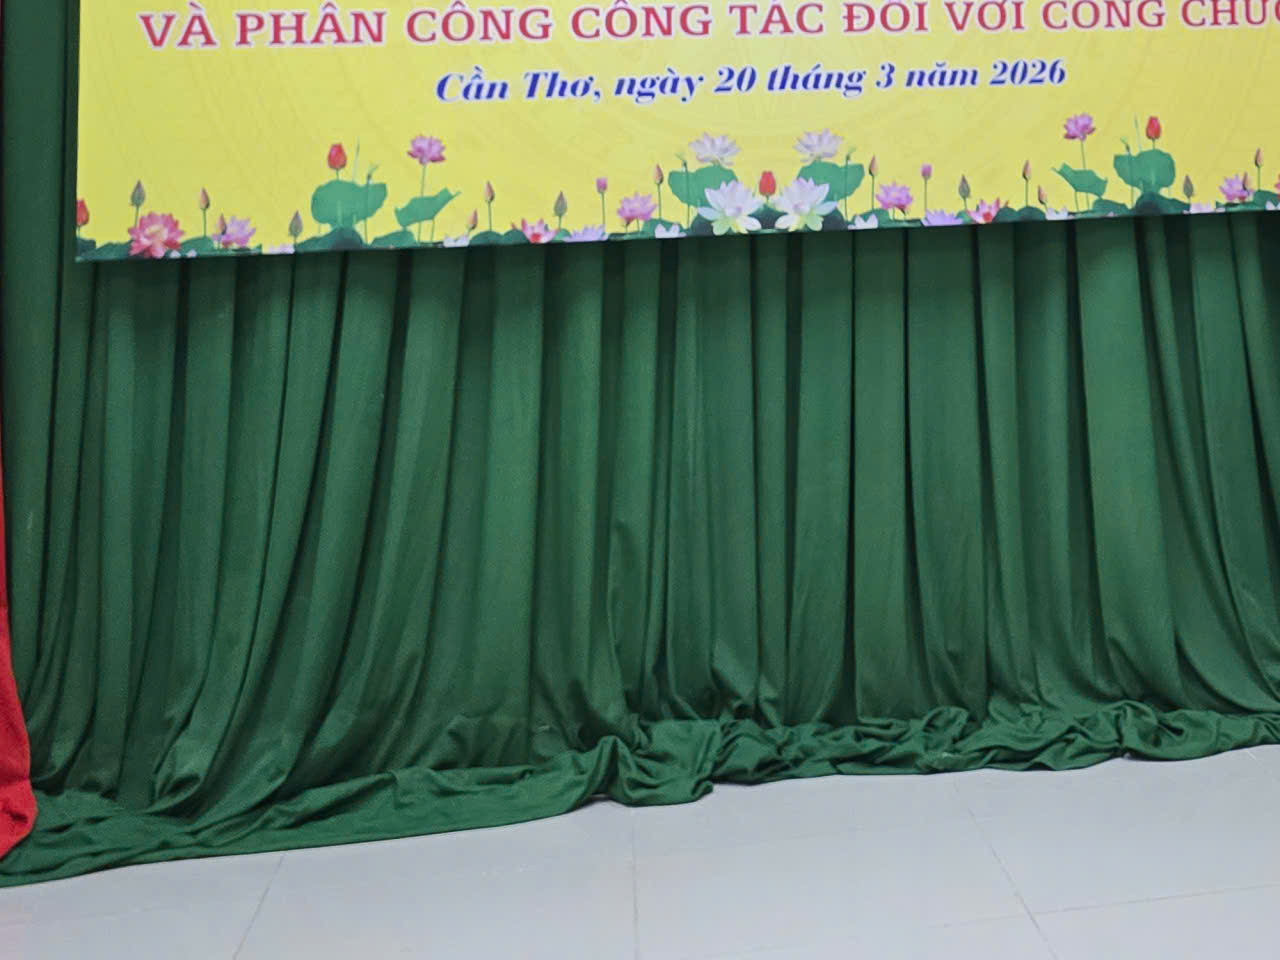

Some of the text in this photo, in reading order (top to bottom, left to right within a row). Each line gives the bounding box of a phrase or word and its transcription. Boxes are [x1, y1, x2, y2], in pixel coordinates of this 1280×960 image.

[140, 1, 217, 47] VÀ
[235, 2, 387, 47] PHÂN
[406, 0, 553, 41] CÔNG
[436, 59, 1066, 104] Cần Thơ, ngày 20 tháng 3 năm 2026
